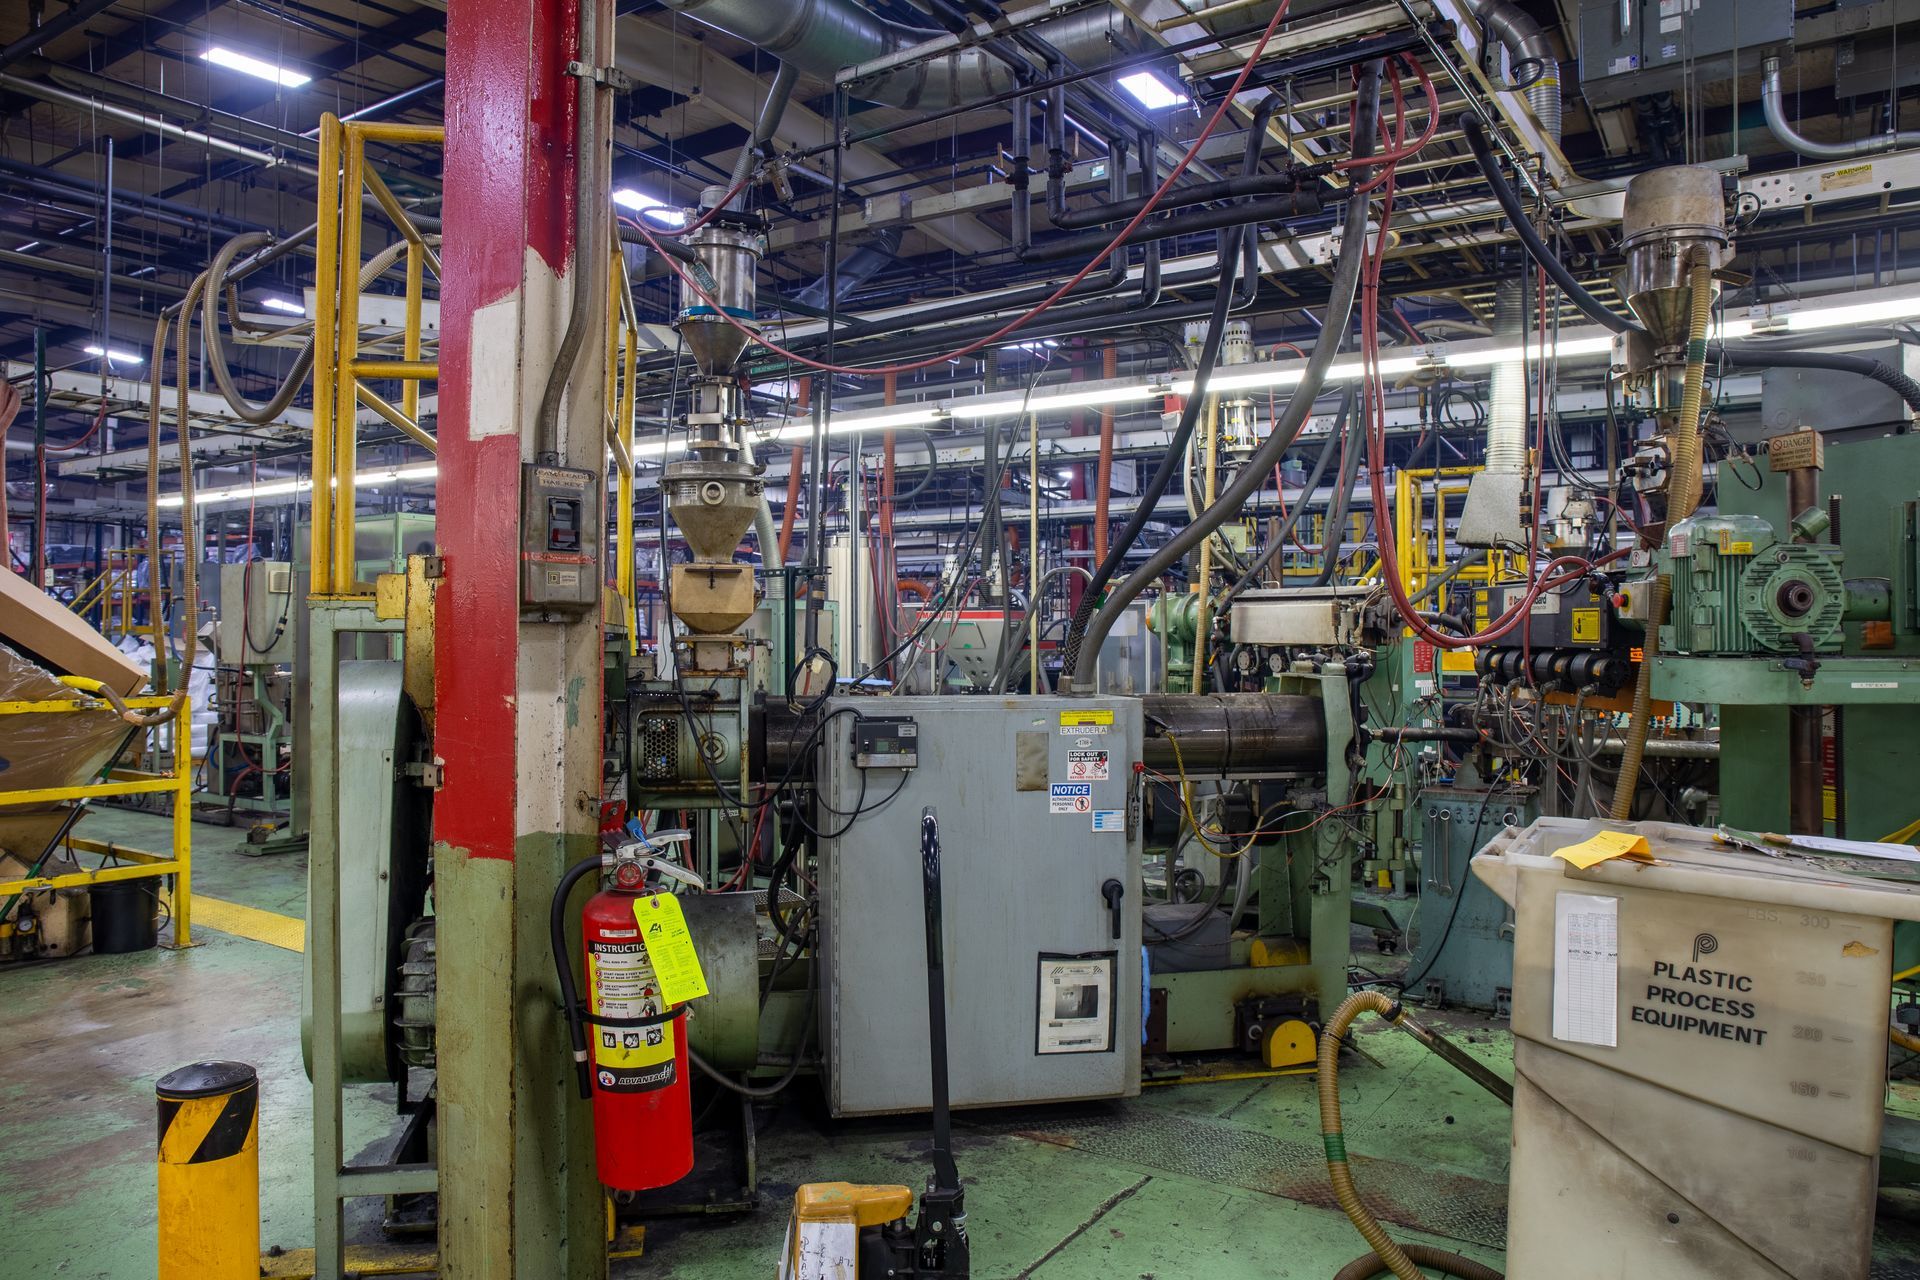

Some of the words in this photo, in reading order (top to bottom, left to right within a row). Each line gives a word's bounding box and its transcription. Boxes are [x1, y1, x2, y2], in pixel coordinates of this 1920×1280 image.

[1783, 437, 1812, 449] DANGER
[1061, 726, 1099, 734] EXTRUDER
[1053, 785, 1088, 795] NOTICE
[1800, 913, 1830, 929] 300
[594, 943, 647, 953] INSTRUCTIO
[1653, 960, 1753, 992] PLASTIC
[1646, 984, 1755, 1019] PROCESS
[1631, 1005, 1768, 1046] EQUIPMENT
[1791, 1024, 1823, 1042] 200
[1789, 1080, 1820, 1097] 150
